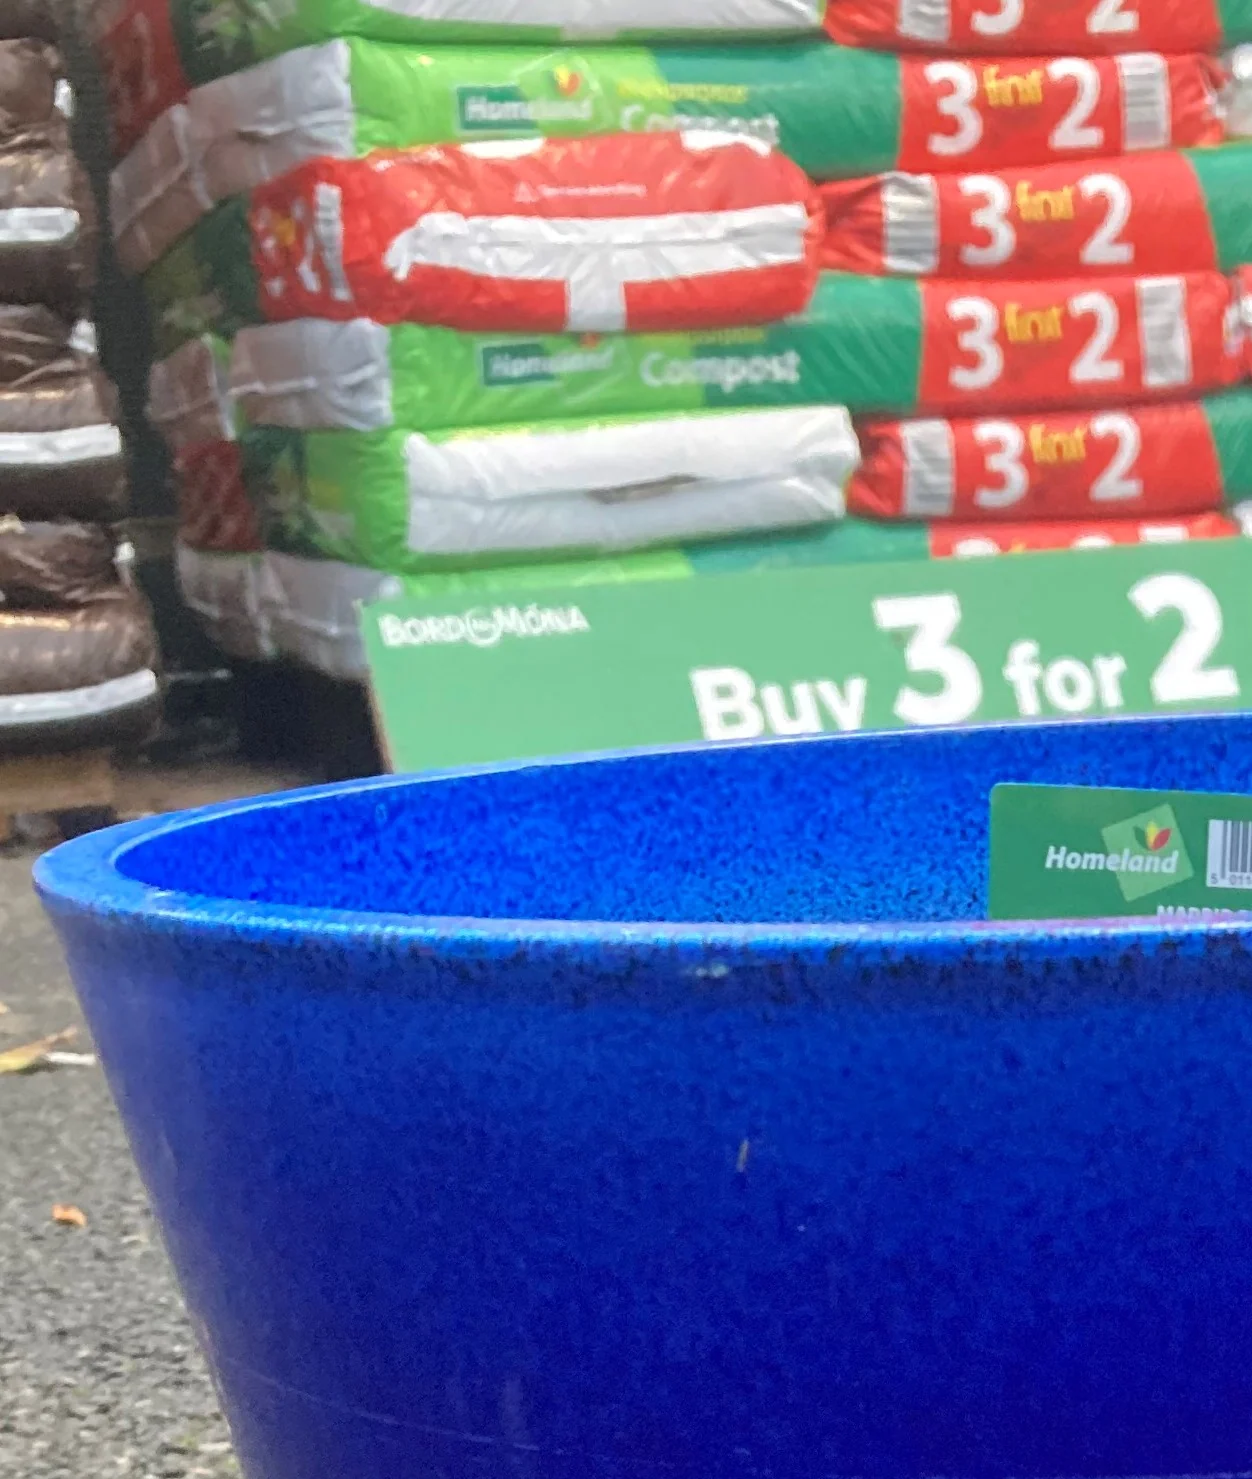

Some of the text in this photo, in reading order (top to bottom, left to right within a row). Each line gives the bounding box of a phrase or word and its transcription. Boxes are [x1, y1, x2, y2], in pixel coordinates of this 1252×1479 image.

[924, 60, 984, 155] 3
[1046, 56, 1104, 149] 2
[957, 173, 1017, 266] 3
[1078, 172, 1135, 265] 2
[639, 349, 801, 393] Compost
[945, 295, 1005, 389] 3
[1066, 291, 1124, 385] 2
[972, 418, 1030, 508] 3
[1089, 411, 1145, 502] 2
[688, 572, 1241, 741] Buy 3 for 2
[1045, 845, 1179, 874] Homeland
[1210, 874, 1219, 885] 5
